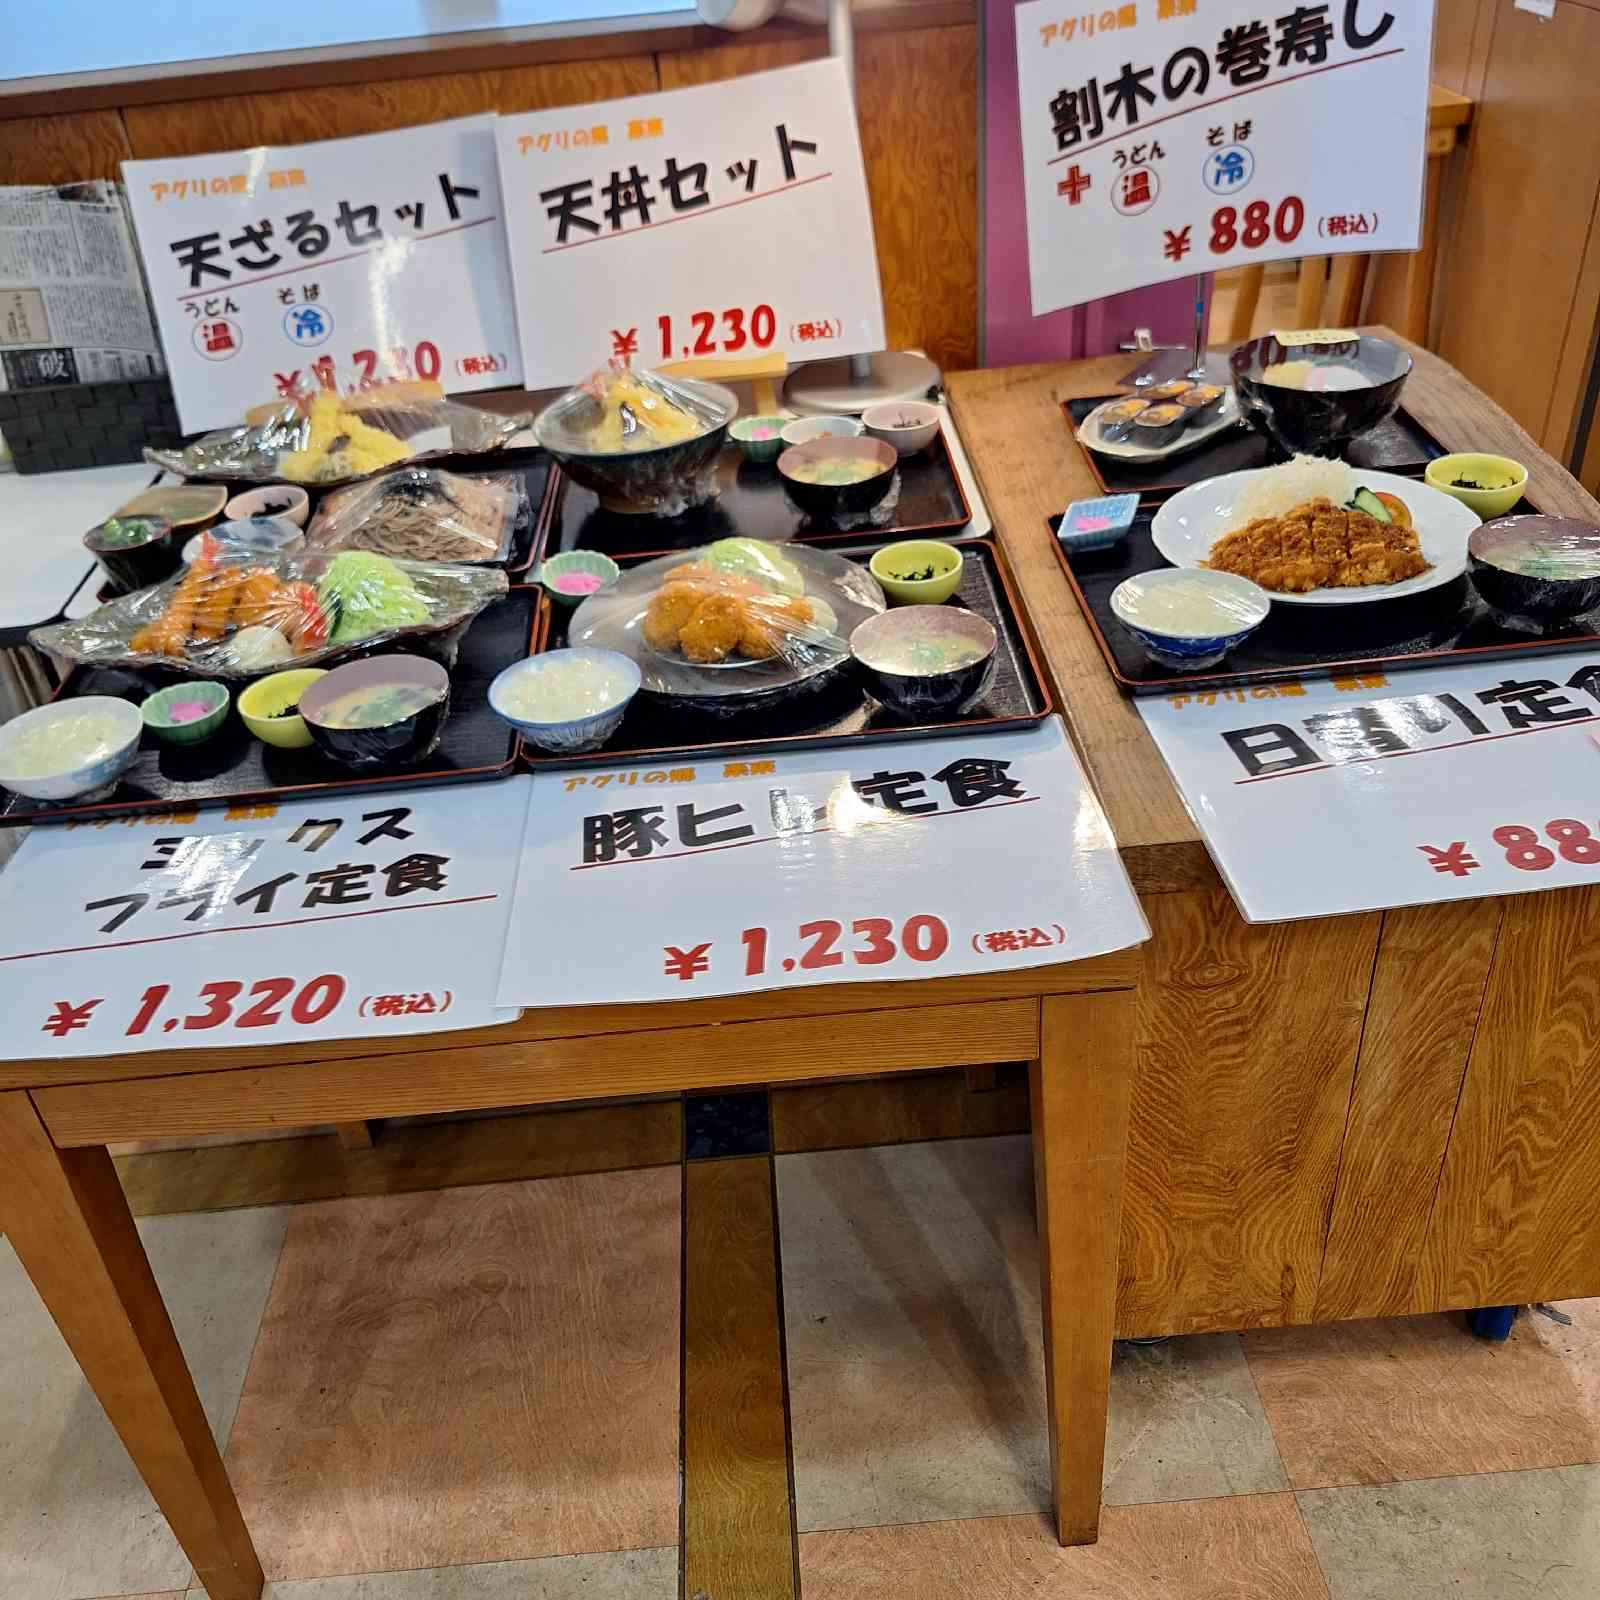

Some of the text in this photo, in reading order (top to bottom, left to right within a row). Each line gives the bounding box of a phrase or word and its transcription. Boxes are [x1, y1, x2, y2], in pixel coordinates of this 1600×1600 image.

[1049, 0, 1396, 150] 割木の巻寿し
[1112, 120, 1252, 167] うどん そば
[540, 124, 817, 242] 天丼セット
[1121, 170, 1151, 207] 温
[1214, 150, 1244, 185] 冷
[169, 173, 480, 287] 天ざるセット
[1209, 196, 1304, 253] 880
[185, 283, 319, 317] うどん そば
[203, 309, 326, 352] 温 冷
[656, 303, 777, 361] 1,230
[1491, 818, 1600, 870] 88
[741, 915, 948, 976] 1,230
[125, 973, 345, 1034] 1,320
